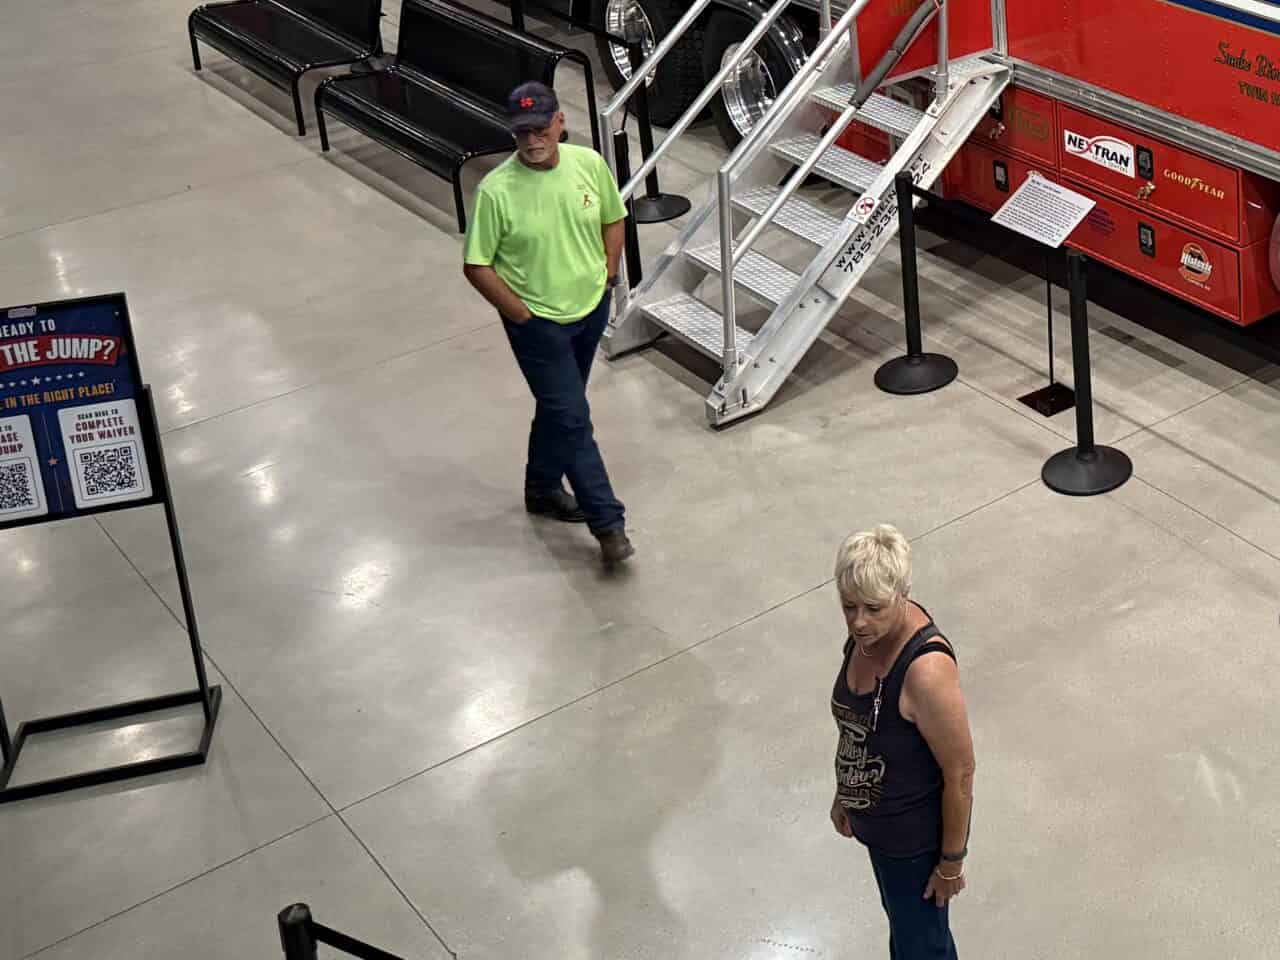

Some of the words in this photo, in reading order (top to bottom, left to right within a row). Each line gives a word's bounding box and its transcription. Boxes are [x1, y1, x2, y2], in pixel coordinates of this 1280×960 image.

[1066, 133, 1131, 168] NEXTRAN
[1163, 168, 1225, 200] GOODYEAR
[40, 318, 56, 333] TO
[3, 340, 41, 366] THE
[46, 338, 116, 360] JUMP?
[5, 398, 17, 409] IN
[20, 394, 40, 406] THE
[43, 387, 75, 403] RIGHT
[79, 382, 115, 397] PLACE!
[69, 433, 95, 445] YOUR
[97, 425, 135, 441] WAIVER
[75, 416, 124, 433] COMPLETE
